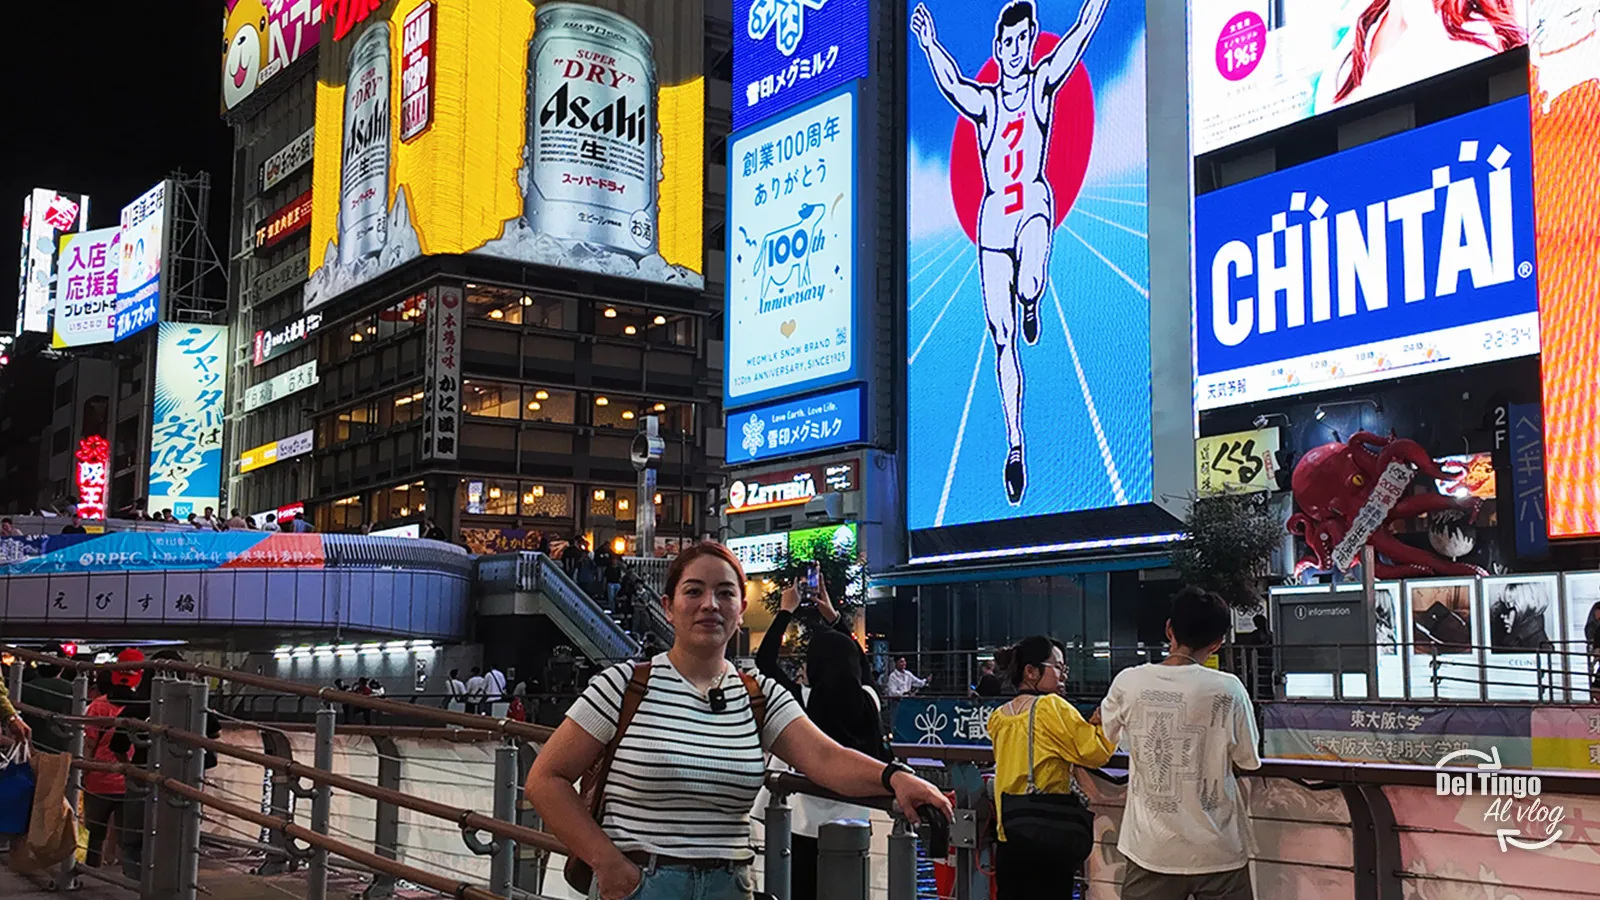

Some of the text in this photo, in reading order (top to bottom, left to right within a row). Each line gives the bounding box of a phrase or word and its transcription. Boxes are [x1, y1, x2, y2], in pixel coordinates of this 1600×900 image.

[576, 49, 617, 67] SUPER
[746, 45, 840, 107] 雪印メグミルク
[540, 81, 646, 147] Asahi
[580, 138, 608, 163] 生
[742, 115, 841, 178] 創業100周年
[1001, 111, 1027, 216] グリコ
[561, 172, 626, 194] スーパードライ
[754, 157, 827, 207] ありがとう
[67, 242, 108, 272] 入店
[780, 346, 802, 360] SNOW
[804, 337, 831, 353] BRAND
[1482, 327, 1532, 351] 22:34
[1207, 378, 1247, 400] 天気予報
[767, 416, 843, 449] 雪印メグミルク
[1211, 438, 1264, 485] くくる
[747, 479, 817, 505] ZETTERIA
[1515, 413, 1545, 543] ペンギンバー
[52, 591, 196, 613] えびす橋
[1308, 607, 1351, 616] information
